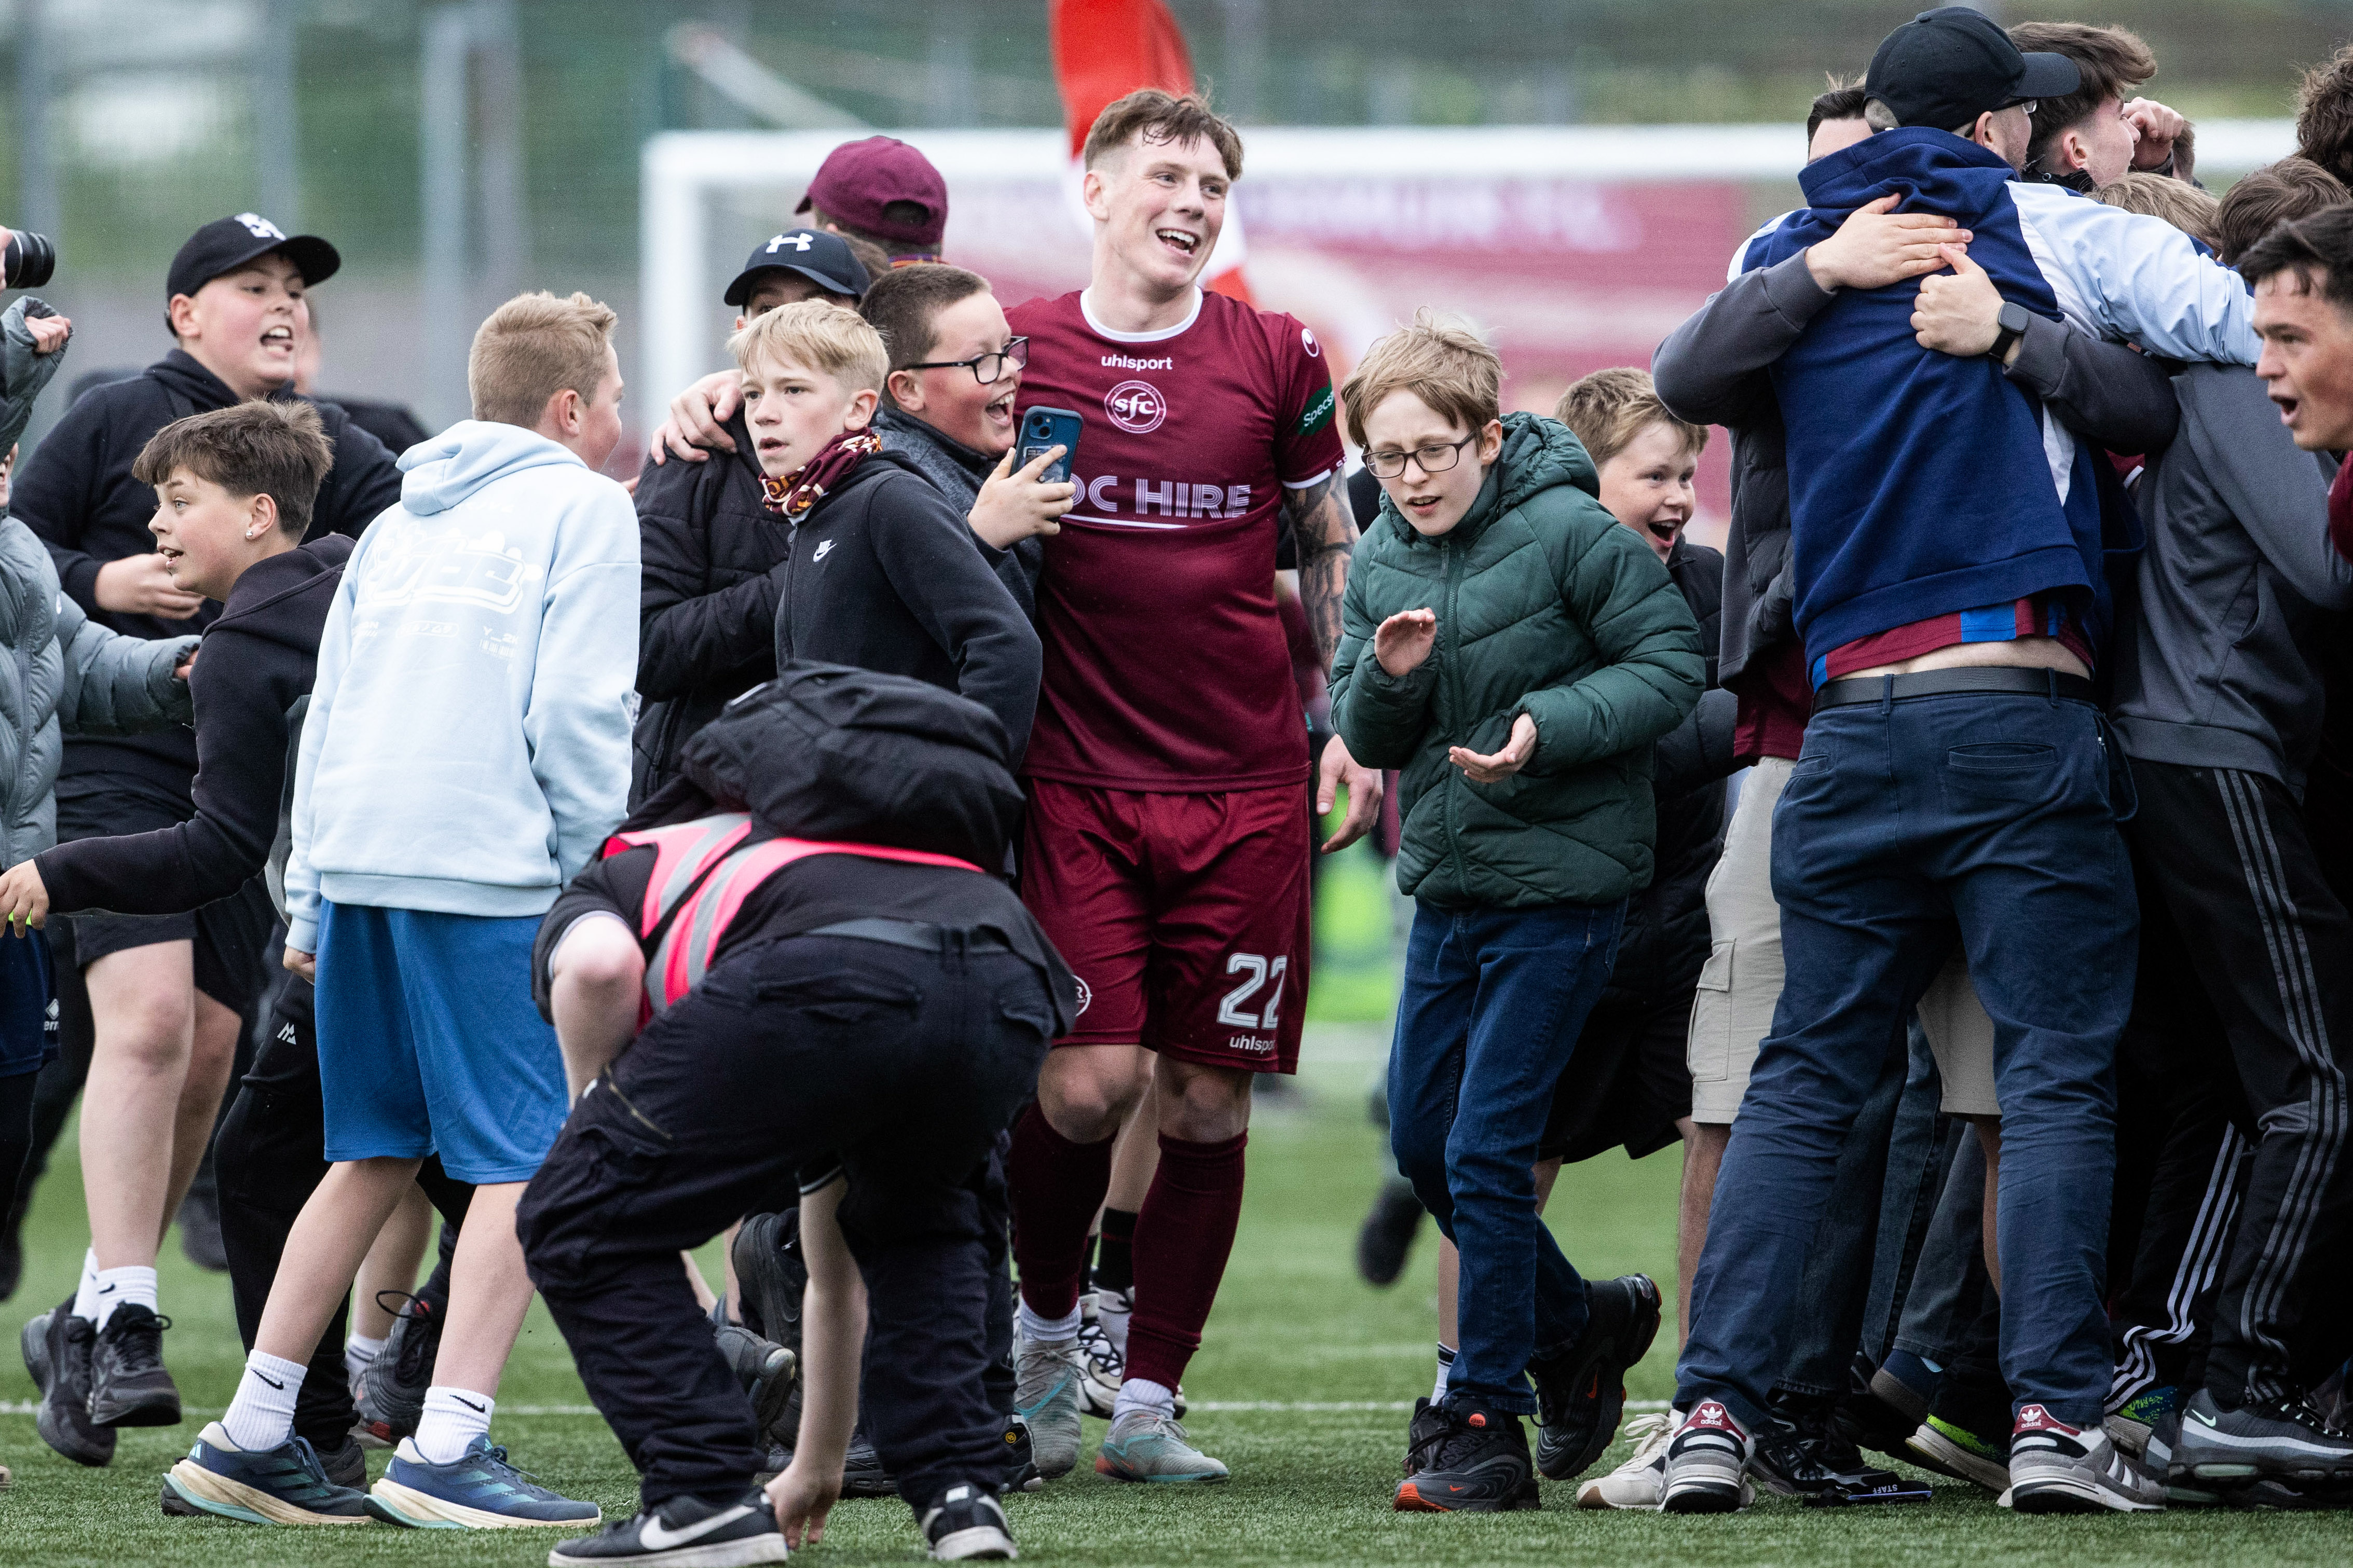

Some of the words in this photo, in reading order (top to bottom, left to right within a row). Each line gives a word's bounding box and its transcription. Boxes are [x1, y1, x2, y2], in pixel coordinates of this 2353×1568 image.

[1101, 353, 1173, 372] uhlsport
[1114, 392, 1156, 421] sfc
[1136, 478, 1251, 518] HIRE
[1216, 952, 1288, 1029] 22
[2021, 1420, 2042, 1428] adidas
[1872, 1484, 1898, 1494] STAFF
